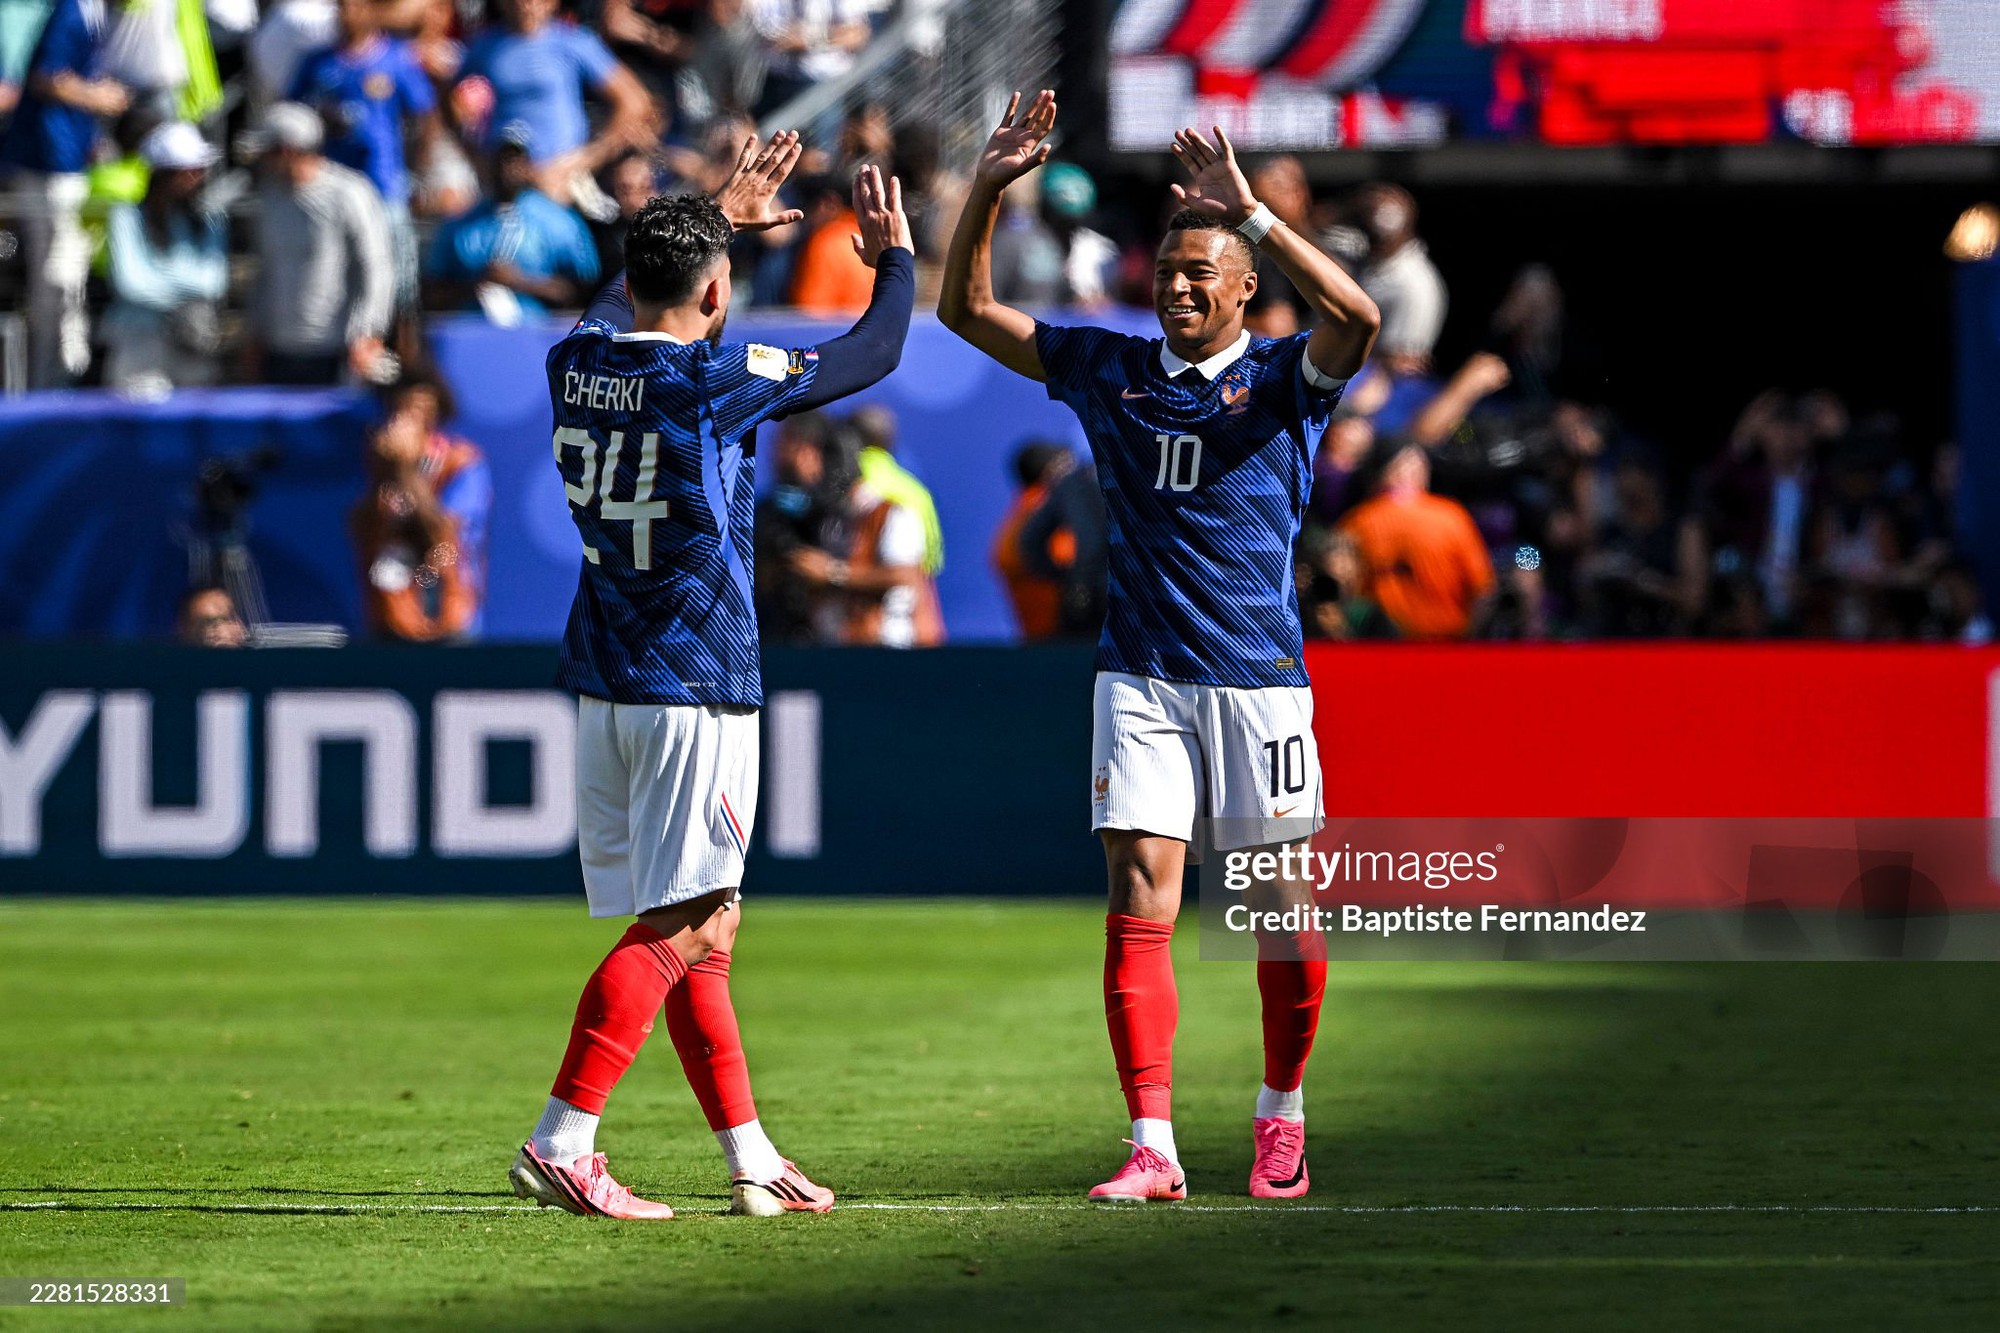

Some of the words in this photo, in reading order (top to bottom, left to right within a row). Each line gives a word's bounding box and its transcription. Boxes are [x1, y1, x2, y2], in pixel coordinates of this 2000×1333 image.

[564, 371, 645, 412] CHERKI
[1154, 434, 1203, 492] 10
[553, 425, 669, 570] 24
[0, 690, 822, 858] YUNDI
[1263, 734, 1306, 798] 10
